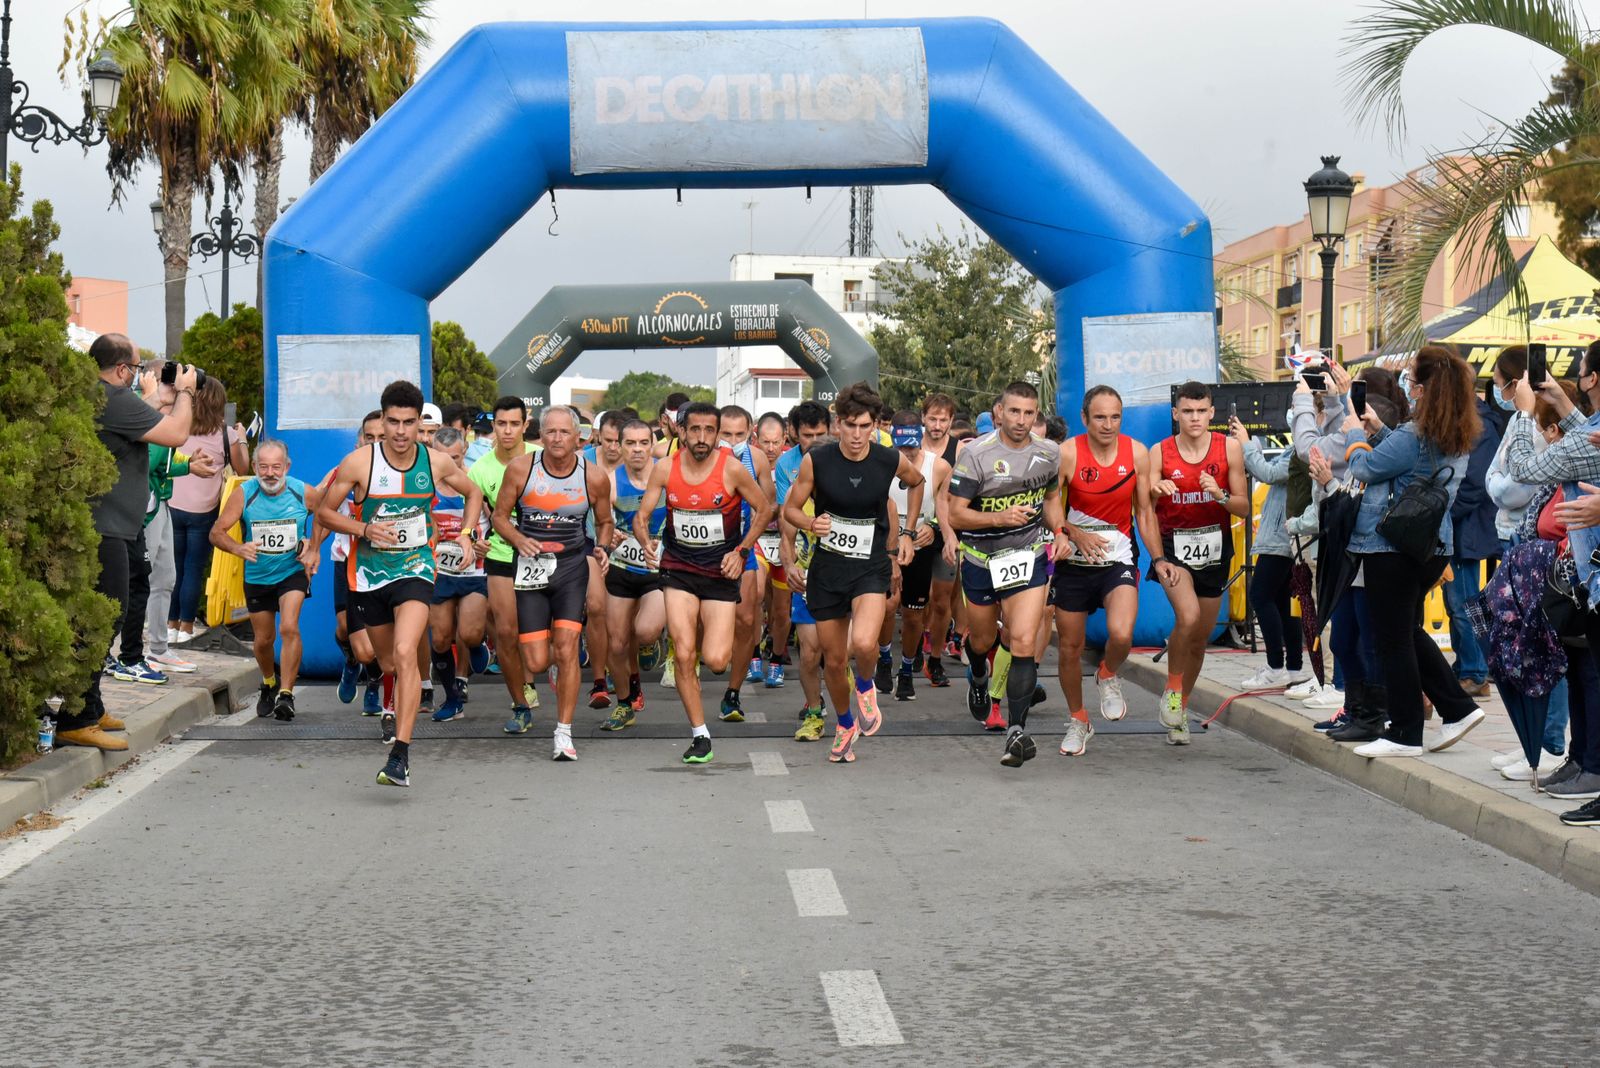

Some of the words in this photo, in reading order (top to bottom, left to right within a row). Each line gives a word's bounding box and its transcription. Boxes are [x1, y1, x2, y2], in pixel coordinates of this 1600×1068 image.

[593, 72, 904, 124] DECATHLON
[730, 304, 768, 318] ESTRECHO
[769, 303, 780, 317] DE
[612, 317, 630, 333] BTT
[637, 311, 723, 335] ALCORNOCALES
[734, 317, 776, 331] GIBRALTAR
[734, 330, 747, 340] LOS
[748, 330, 777, 339] BARRIOS
[1095, 346, 1213, 375] DECATHLON
[818, 391, 833, 401] LOS
[681, 524, 709, 539] 500
[260, 534, 284, 548] 162
[829, 531, 858, 549] 289
[1183, 544, 1210, 561] 244
[1000, 561, 1028, 582] 297
